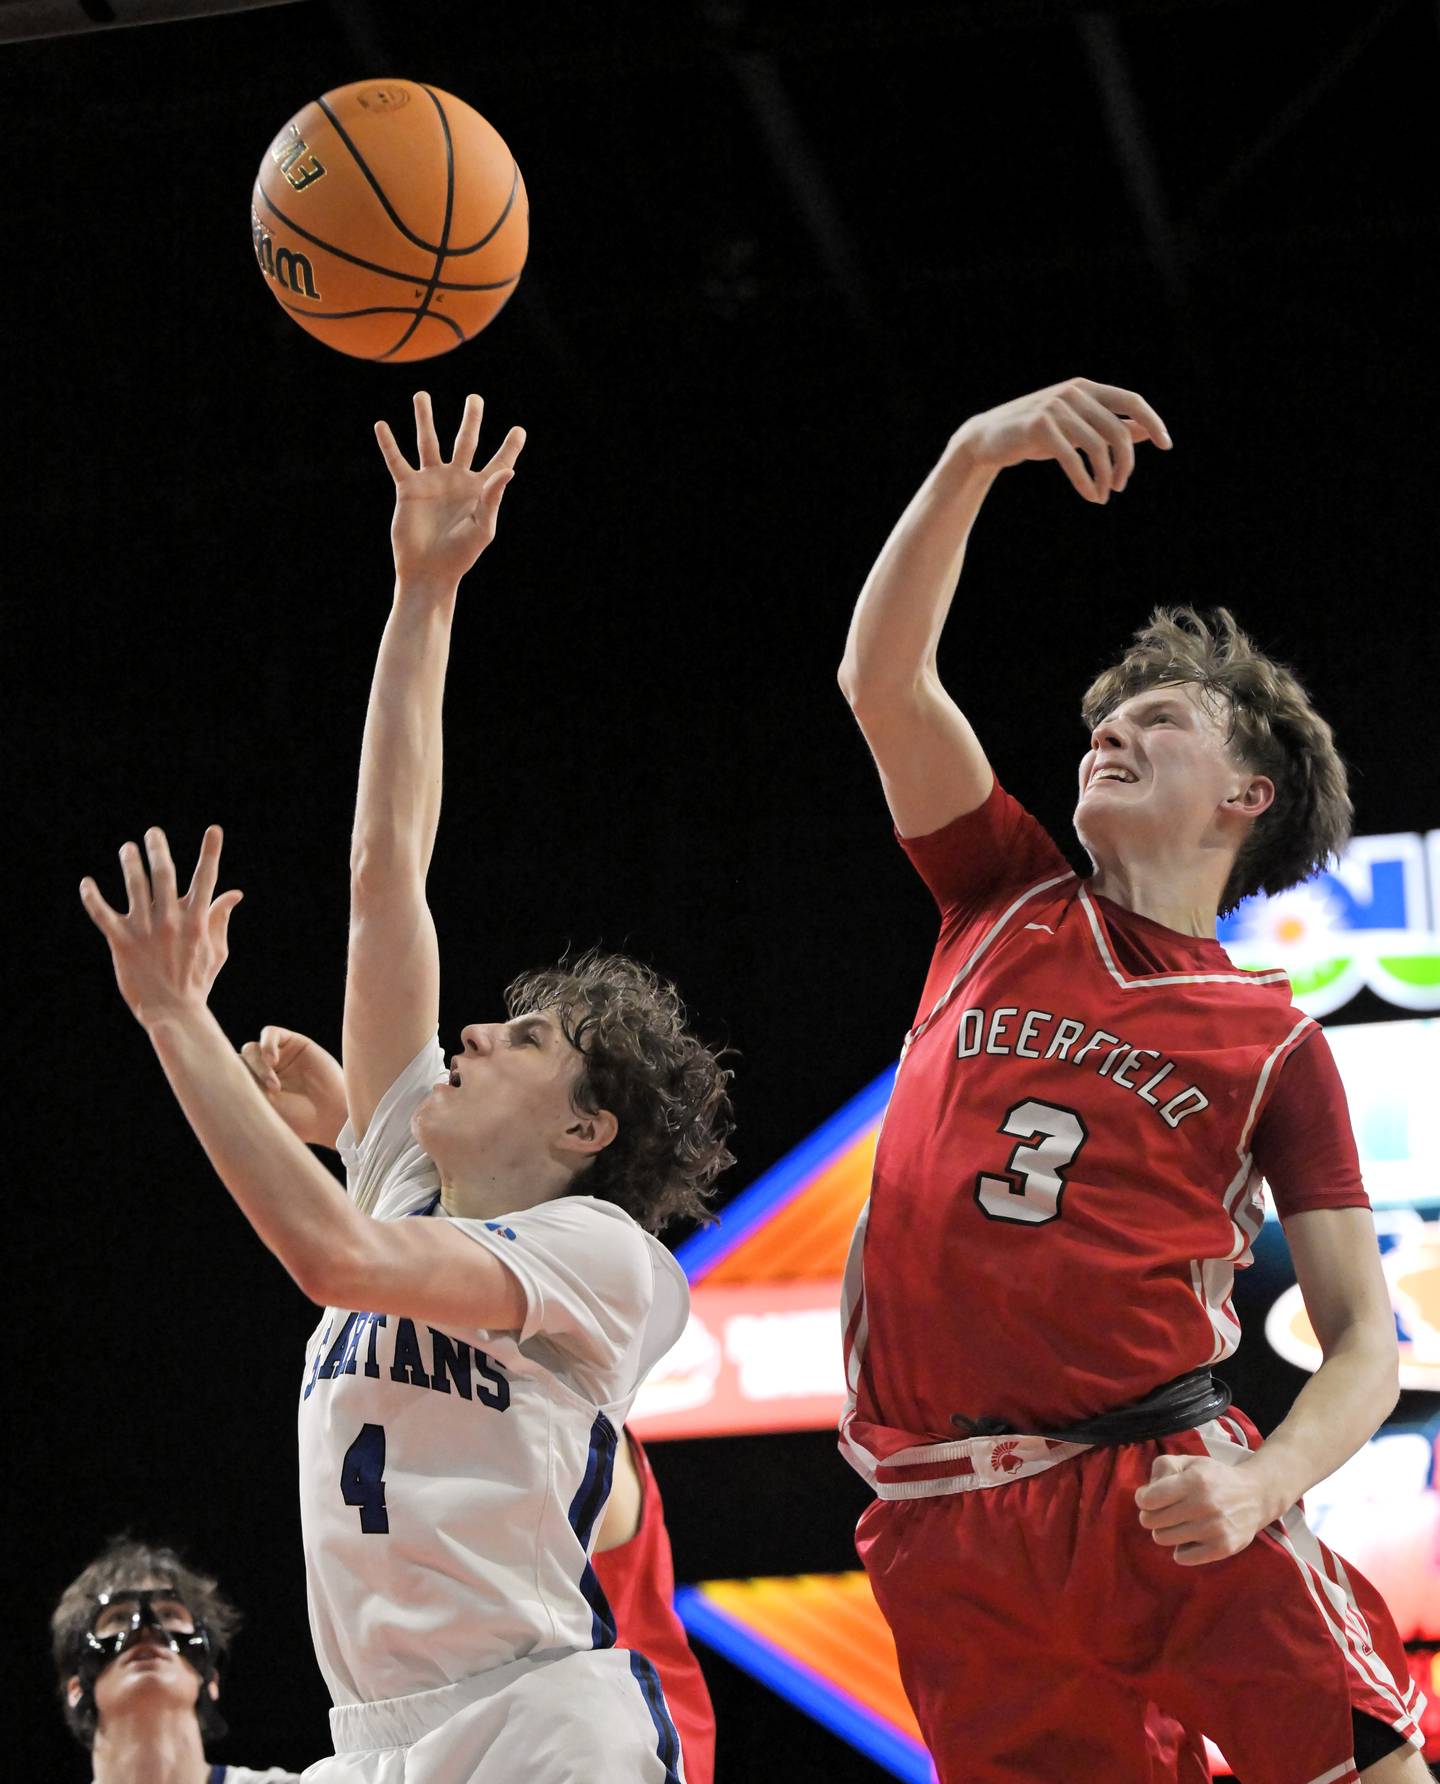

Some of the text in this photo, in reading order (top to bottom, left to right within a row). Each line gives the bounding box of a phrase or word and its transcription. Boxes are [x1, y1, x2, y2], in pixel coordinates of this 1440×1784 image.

[957, 1007, 1210, 1130] DEERFIELD
[973, 1096, 1089, 1227] 3
[340, 1423, 389, 1534] 4
